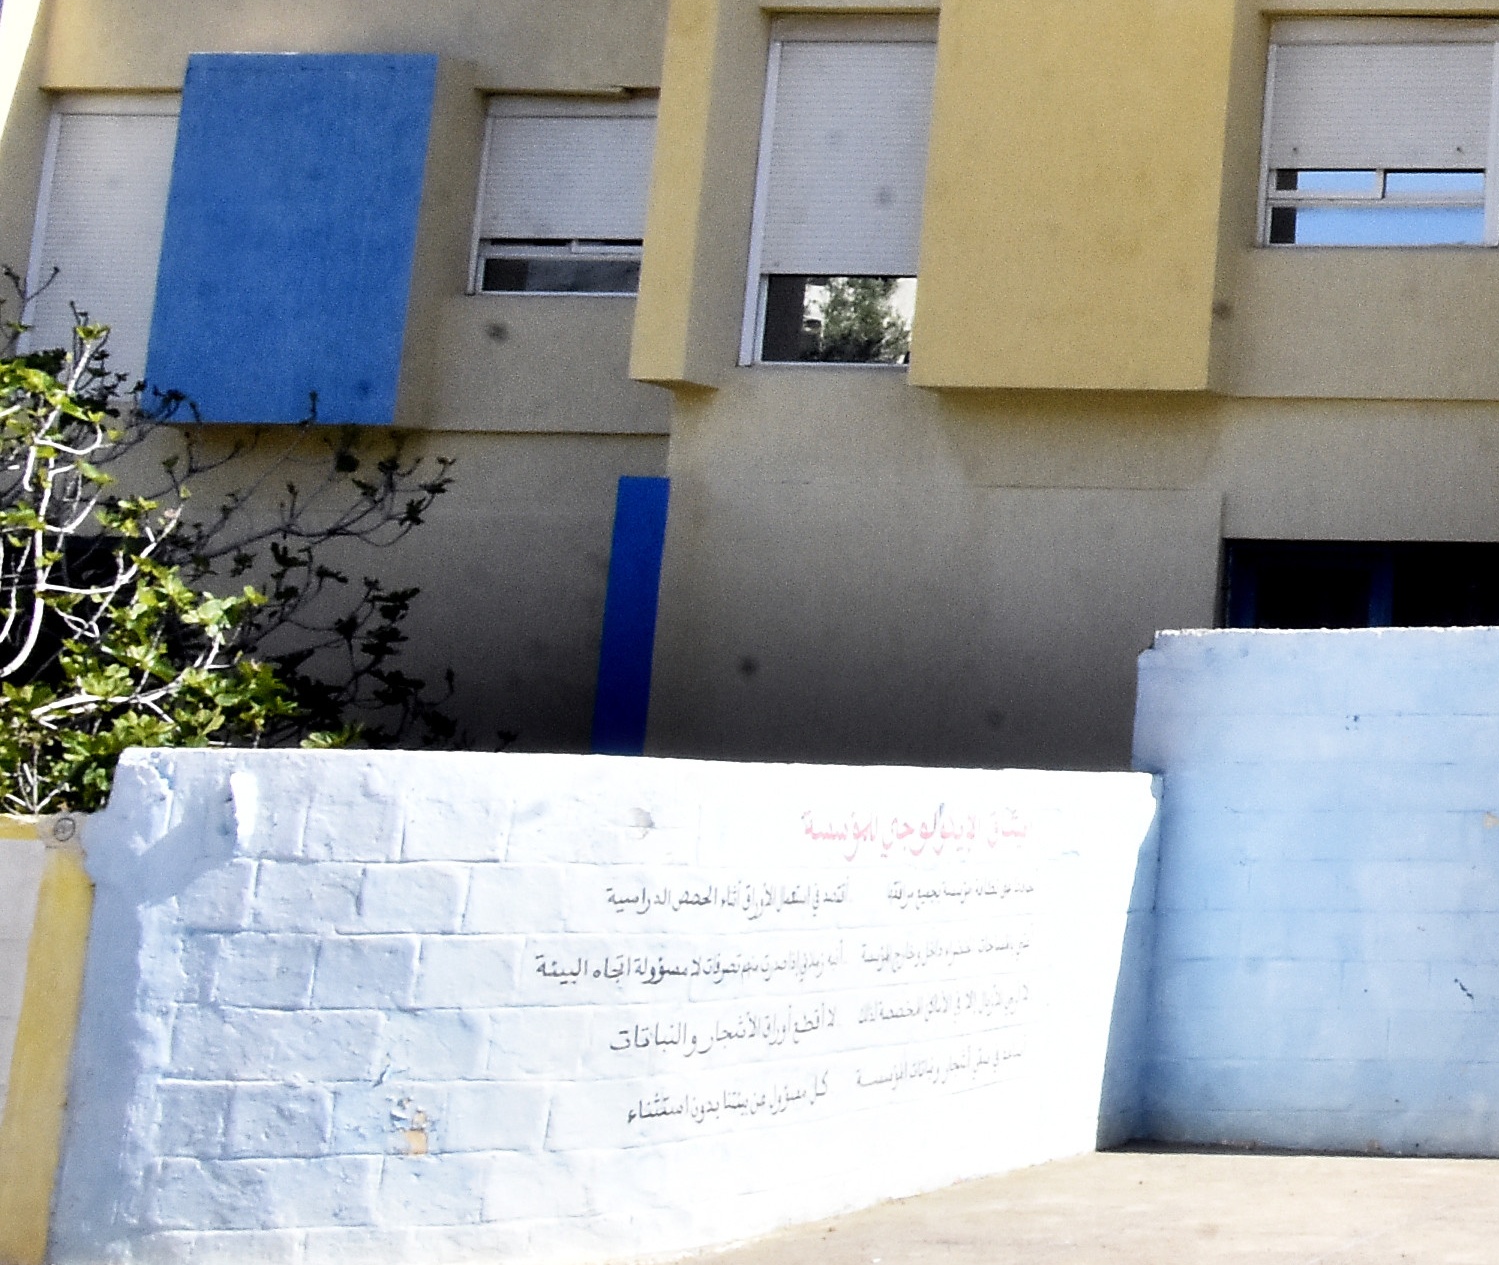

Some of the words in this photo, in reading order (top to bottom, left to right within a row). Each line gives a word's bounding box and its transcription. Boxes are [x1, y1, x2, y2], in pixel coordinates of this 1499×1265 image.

[604, 886, 672, 916] الدراسية
[534, 952, 588, 986] البيئة
[809, 1068, 829, 1107] كل
